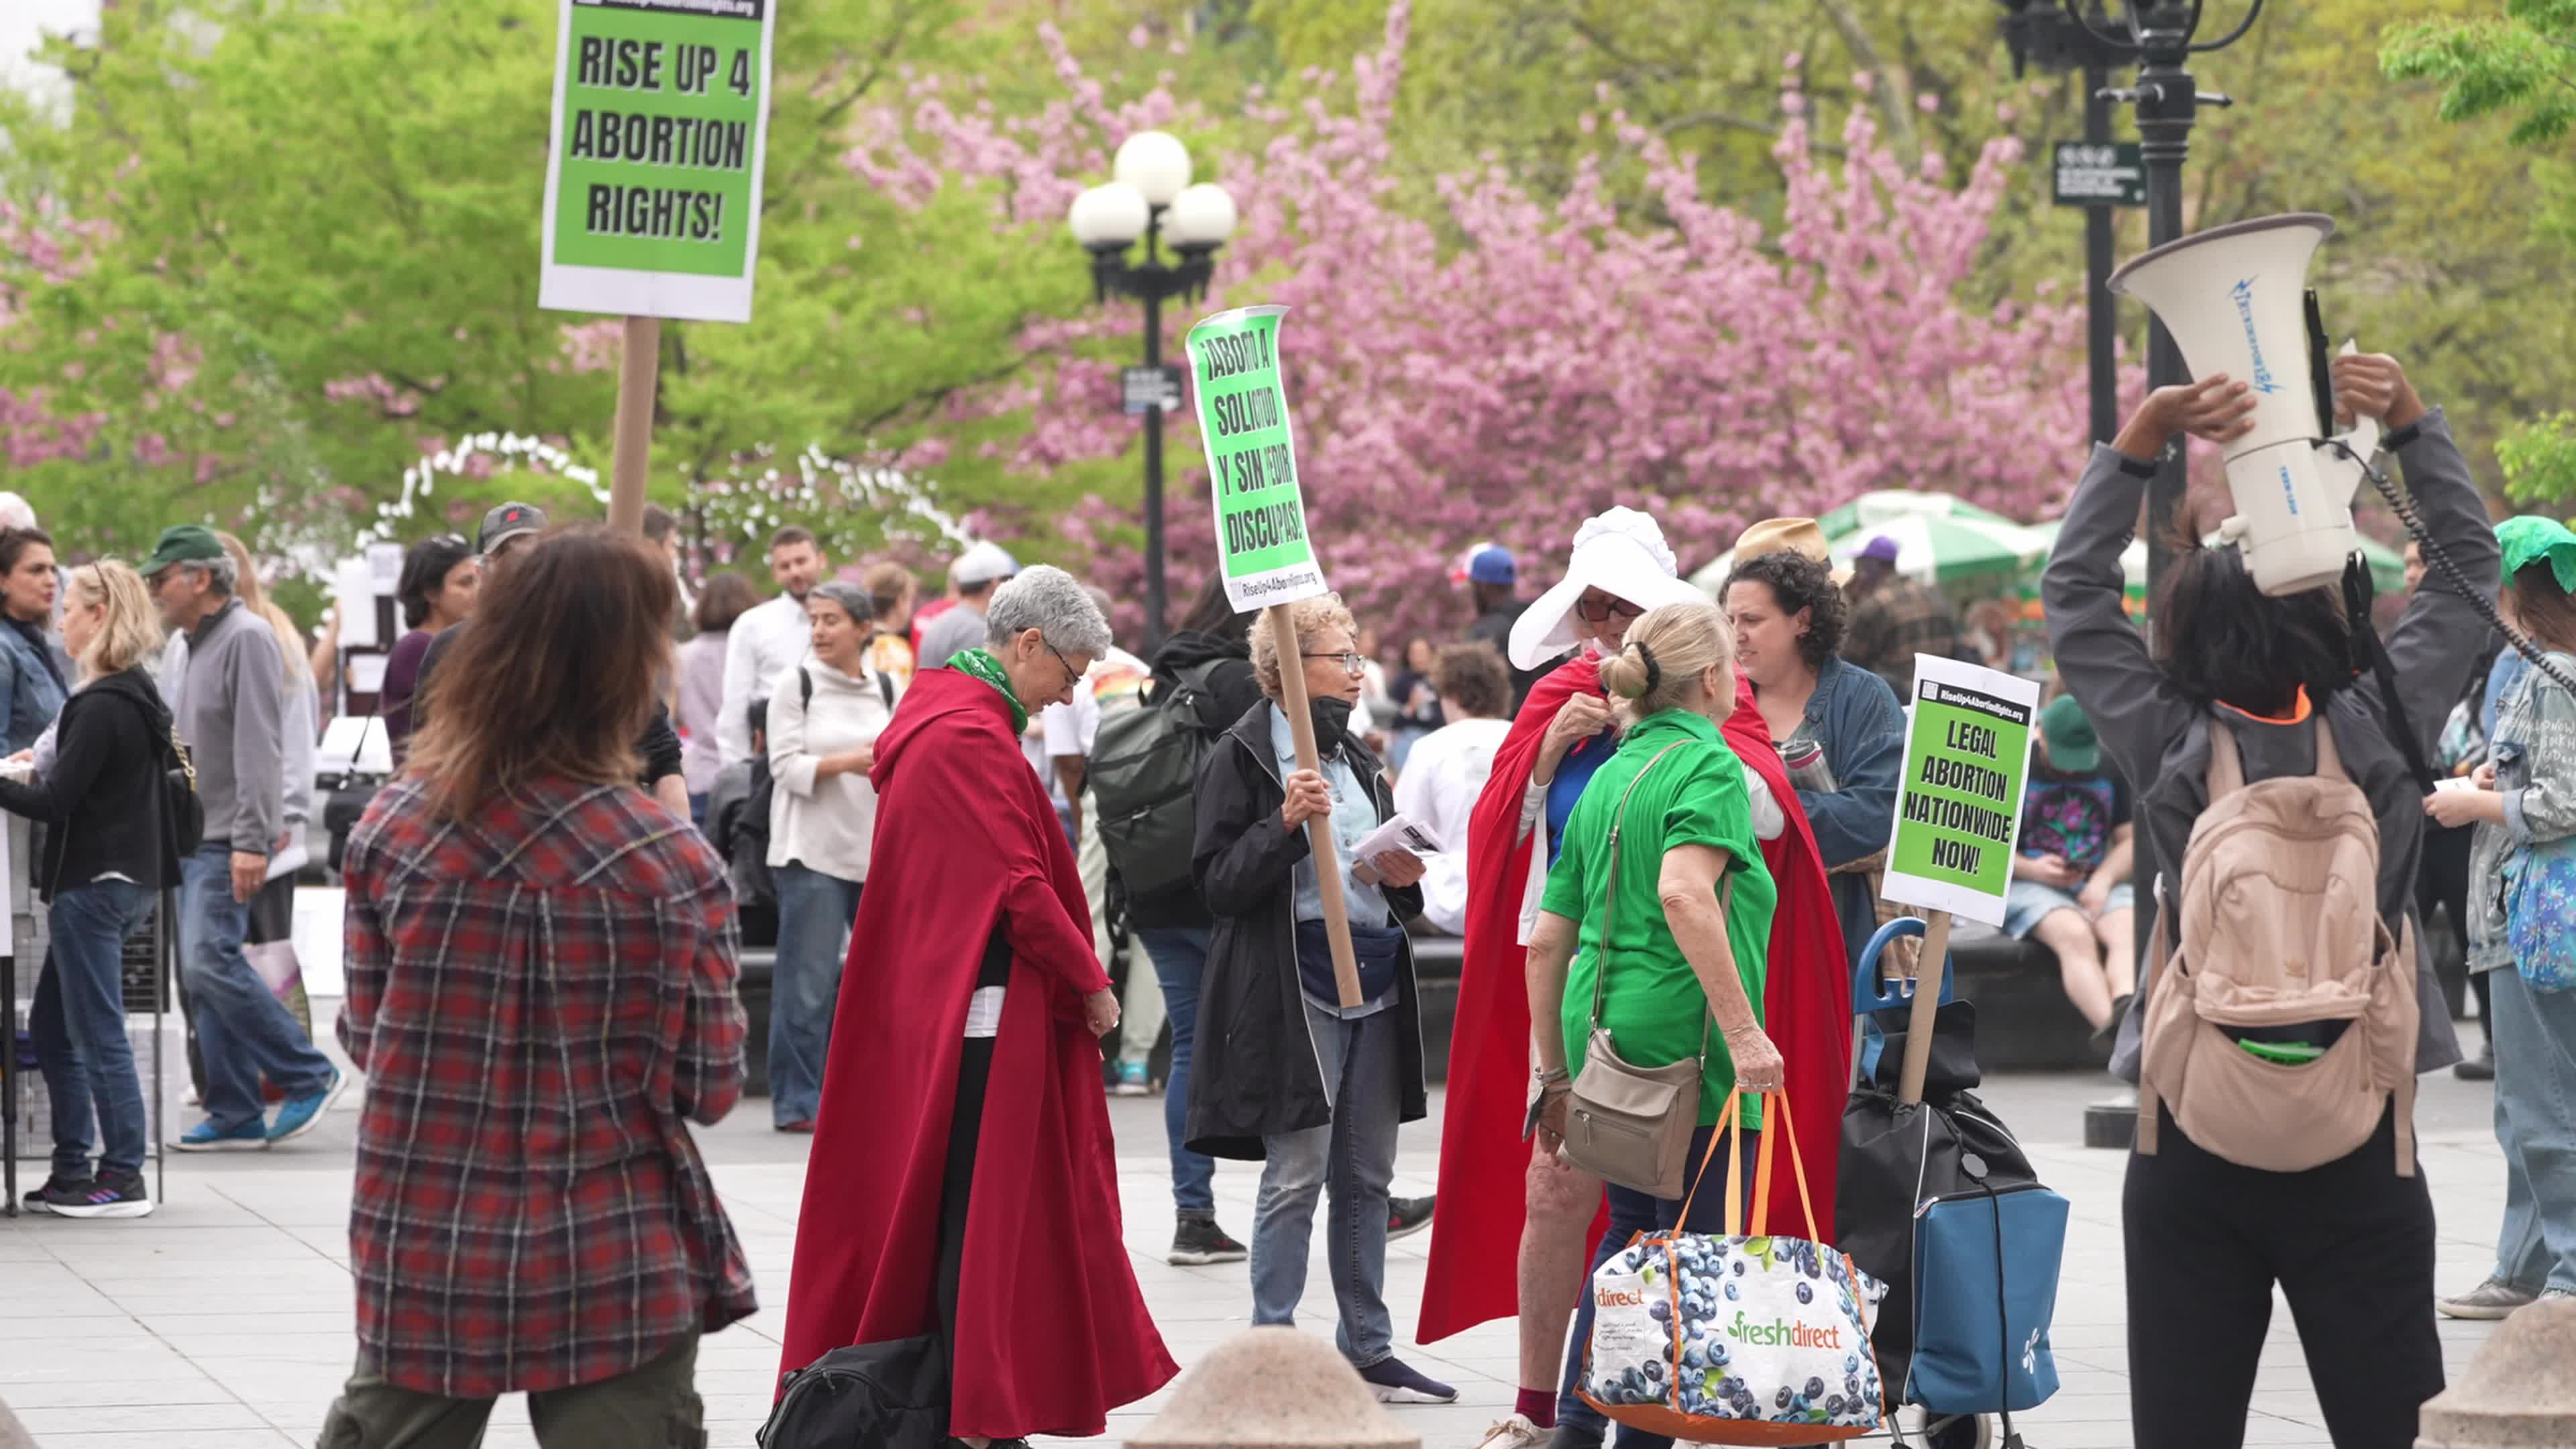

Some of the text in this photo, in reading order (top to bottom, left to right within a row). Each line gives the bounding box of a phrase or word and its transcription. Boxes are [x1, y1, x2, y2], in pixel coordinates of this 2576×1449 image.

[578, 36, 752, 100] RISE UP 4
[571, 109, 747, 172] ABORTION
[586, 183, 724, 243] RIGHTS!
[1259, 328, 1270, 369] A
[1217, 455, 1230, 496] Y
[1234, 448, 1265, 493] SIN
[1226, 500, 1302, 555] DISCUPAS!
[1946, 720, 1997, 761] LEGAL
[1921, 755, 2008, 803] ABORTION
[1903, 791, 2013, 845] NATIONWIDE
[1931, 838, 1981, 875] NOW!
[1596, 1287, 1644, 1307] direct
[1728, 1311, 1841, 1349] freshdirect
